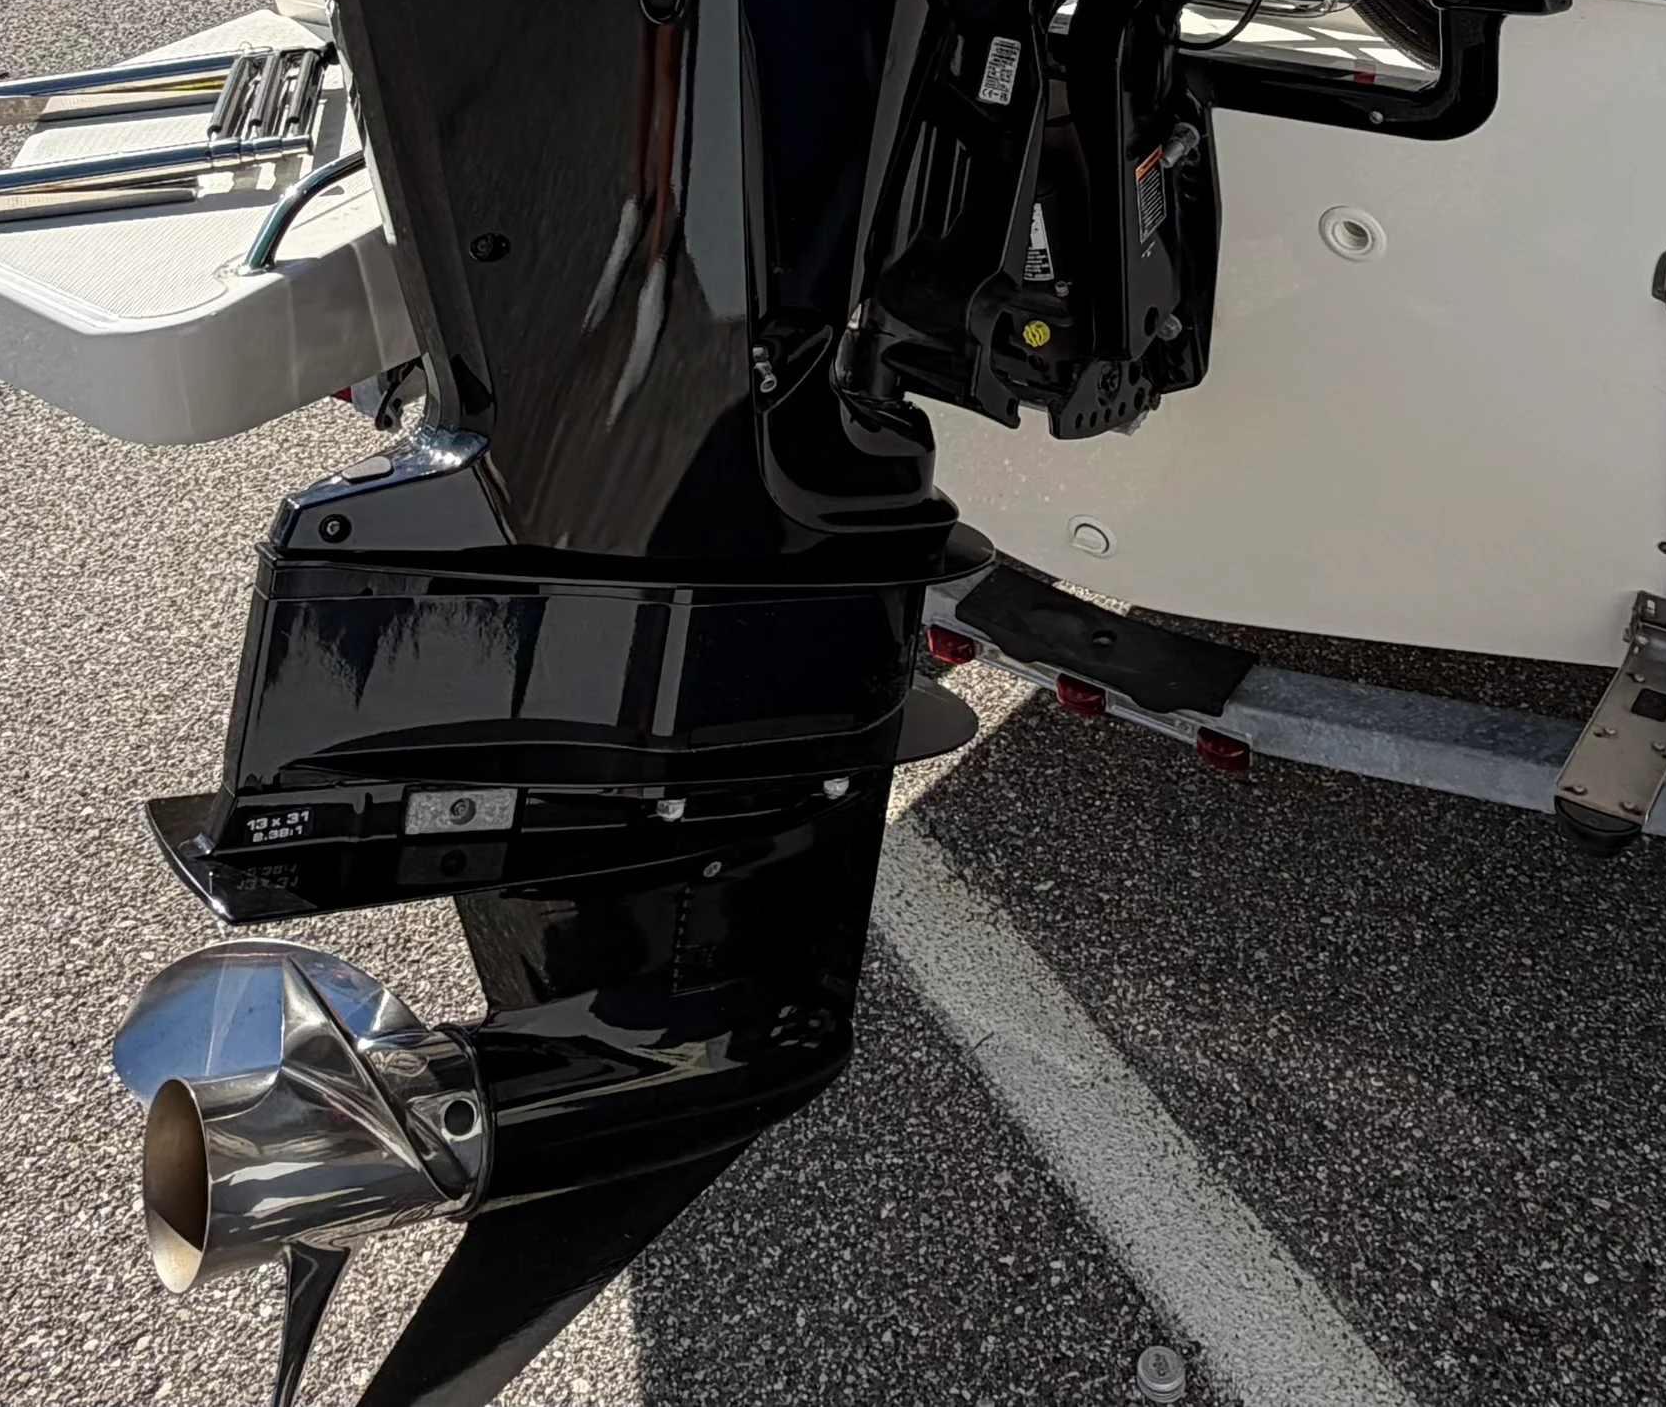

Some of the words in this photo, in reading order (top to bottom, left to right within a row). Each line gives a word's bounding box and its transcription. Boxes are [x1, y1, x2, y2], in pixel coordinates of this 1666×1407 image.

[246, 817, 269, 831] 13
[271, 817, 281, 828] x
[286, 810, 310, 825] 31
